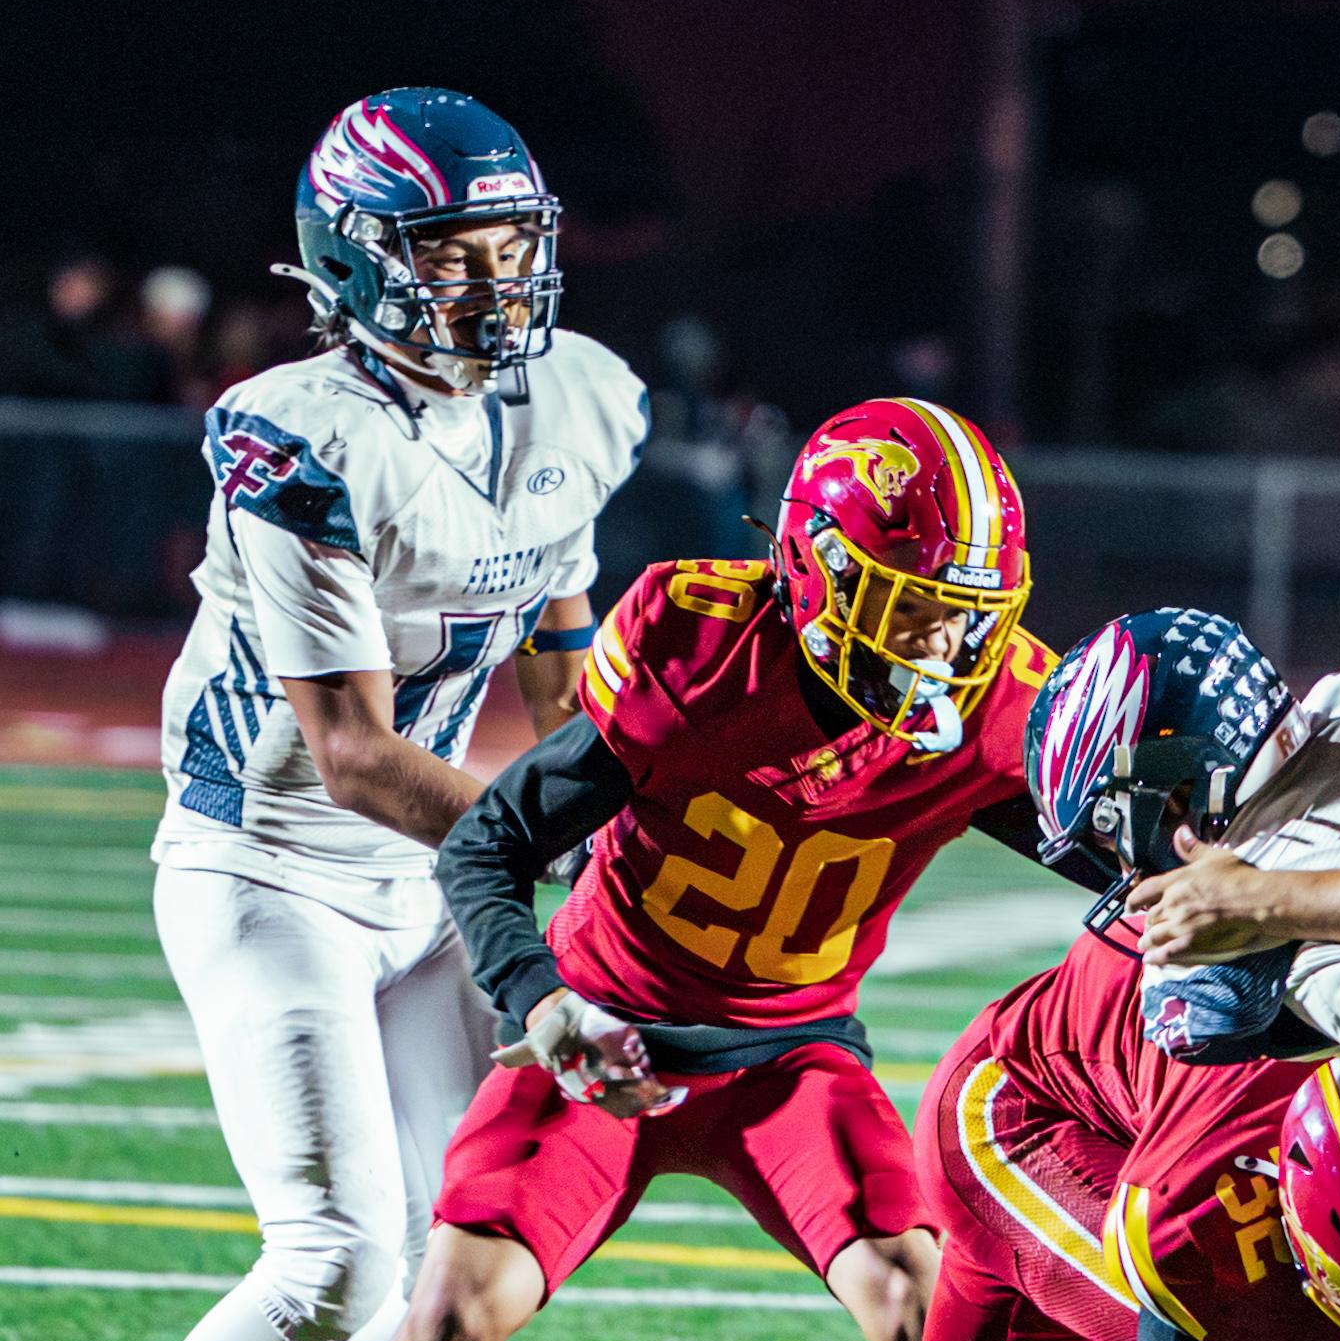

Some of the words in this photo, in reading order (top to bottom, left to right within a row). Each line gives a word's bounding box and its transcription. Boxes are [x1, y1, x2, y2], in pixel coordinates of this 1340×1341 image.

[462, 544, 549, 595] FREEDOM
[946, 566, 1001, 589] Riddell
[641, 791, 897, 985] 20
